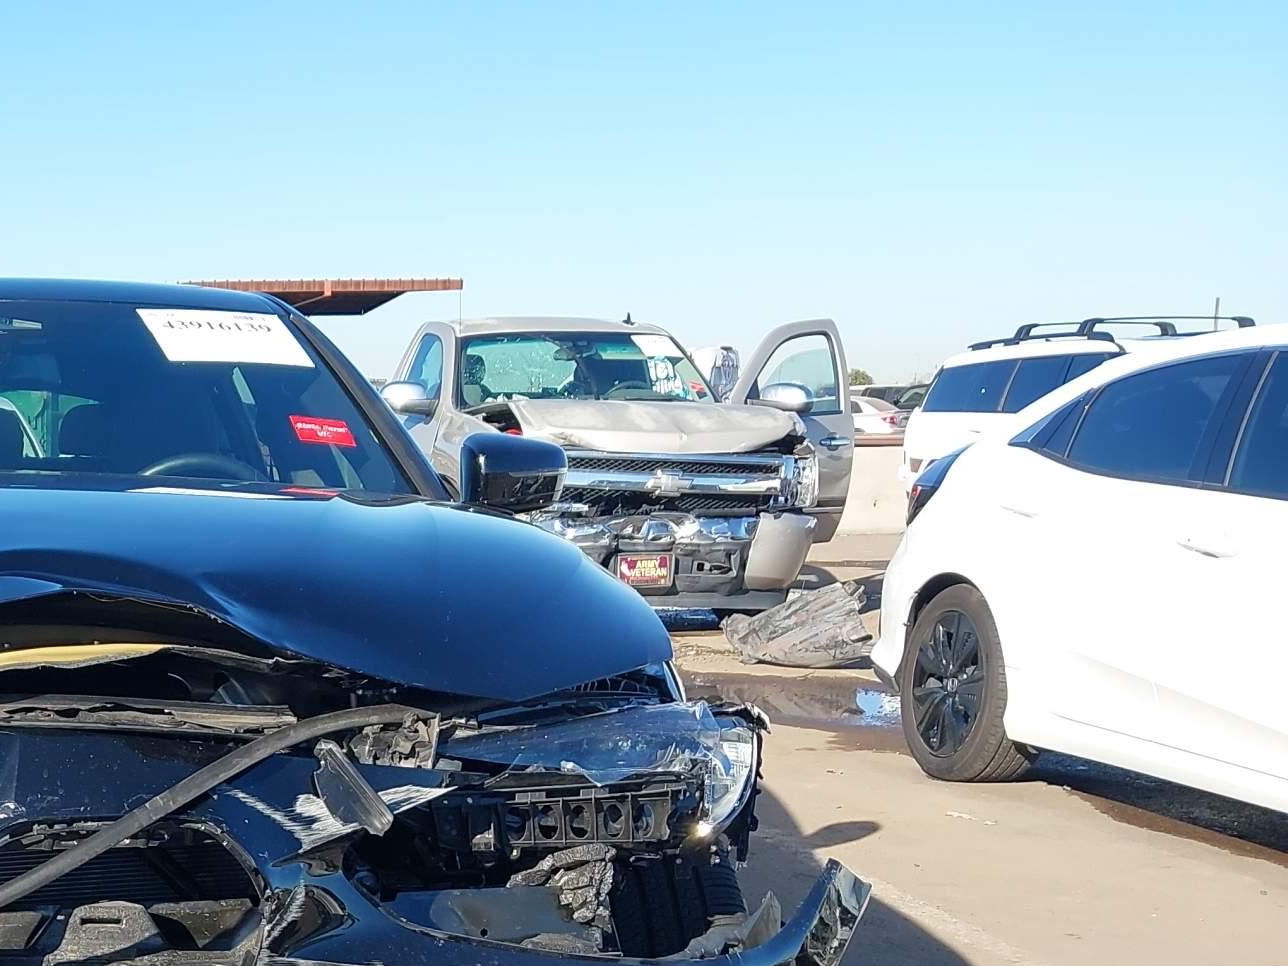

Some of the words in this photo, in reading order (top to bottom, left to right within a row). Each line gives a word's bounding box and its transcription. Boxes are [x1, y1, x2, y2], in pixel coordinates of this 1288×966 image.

[162, 320, 272, 333] 43916139
[635, 559, 660, 569] ARMY
[630, 567, 667, 577] VETERAN
